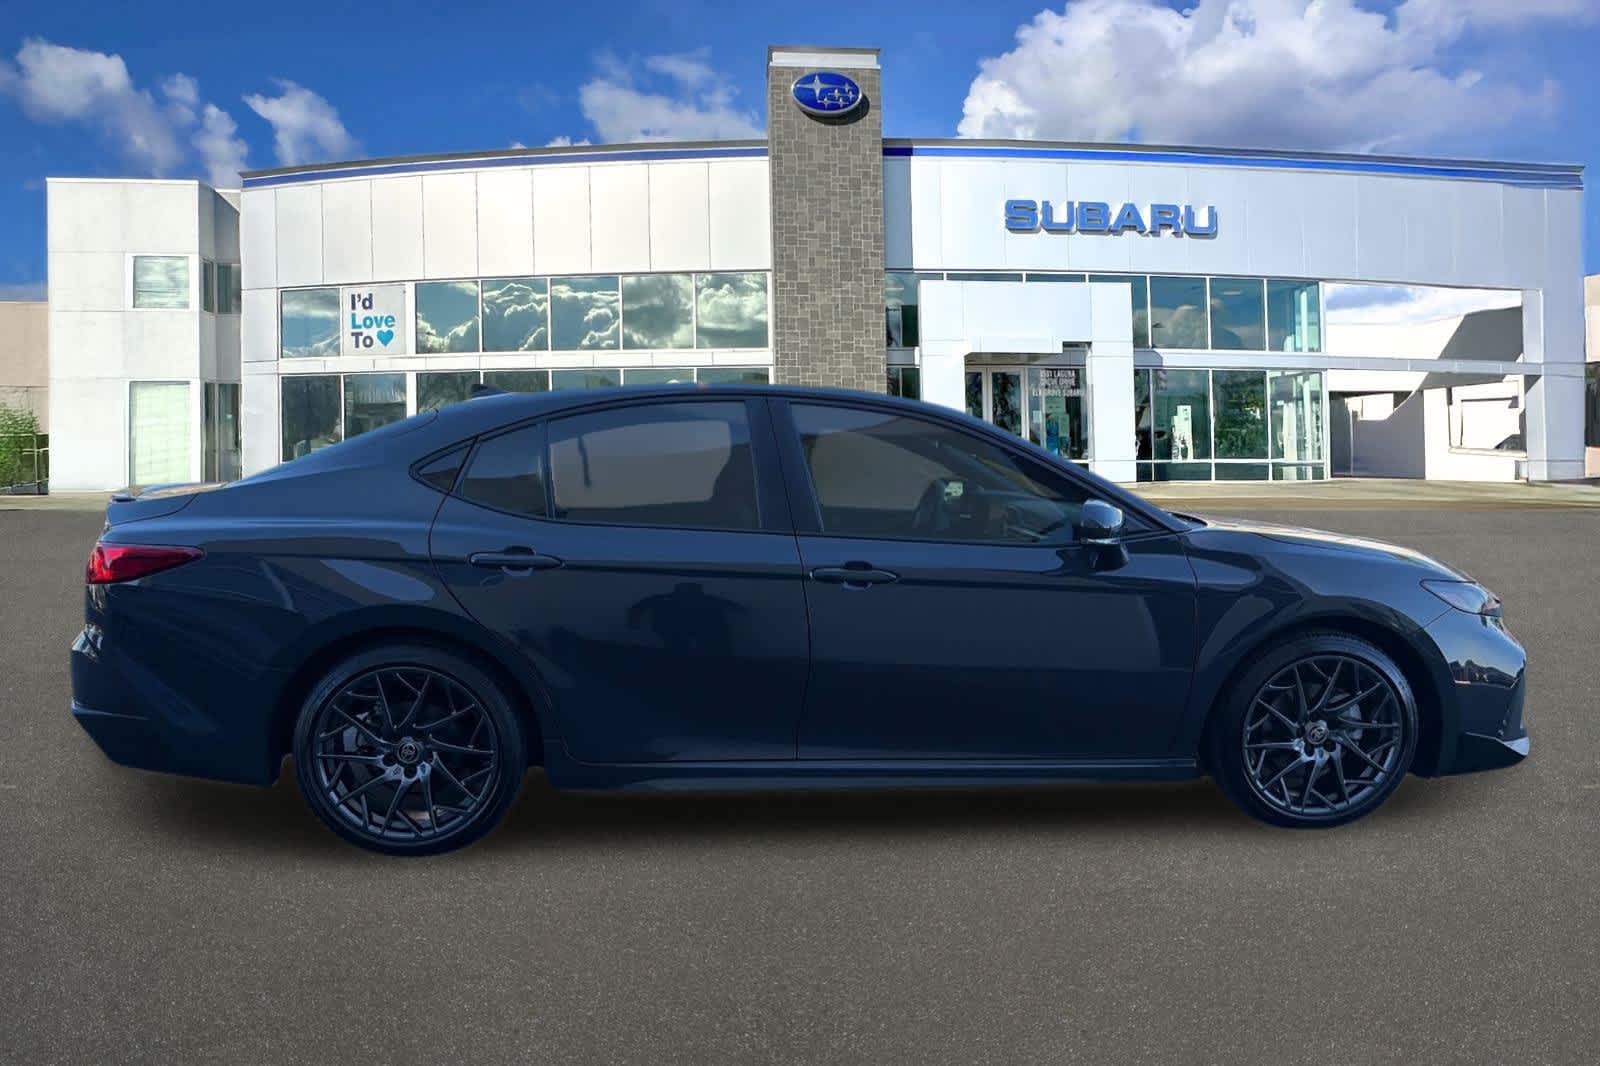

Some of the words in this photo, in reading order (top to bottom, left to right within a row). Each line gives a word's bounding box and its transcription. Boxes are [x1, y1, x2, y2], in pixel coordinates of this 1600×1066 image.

[1004, 199, 1217, 239] SUBARU
[351, 293, 373, 310] I'd
[351, 313, 396, 329] Love
[351, 332, 374, 348] To
